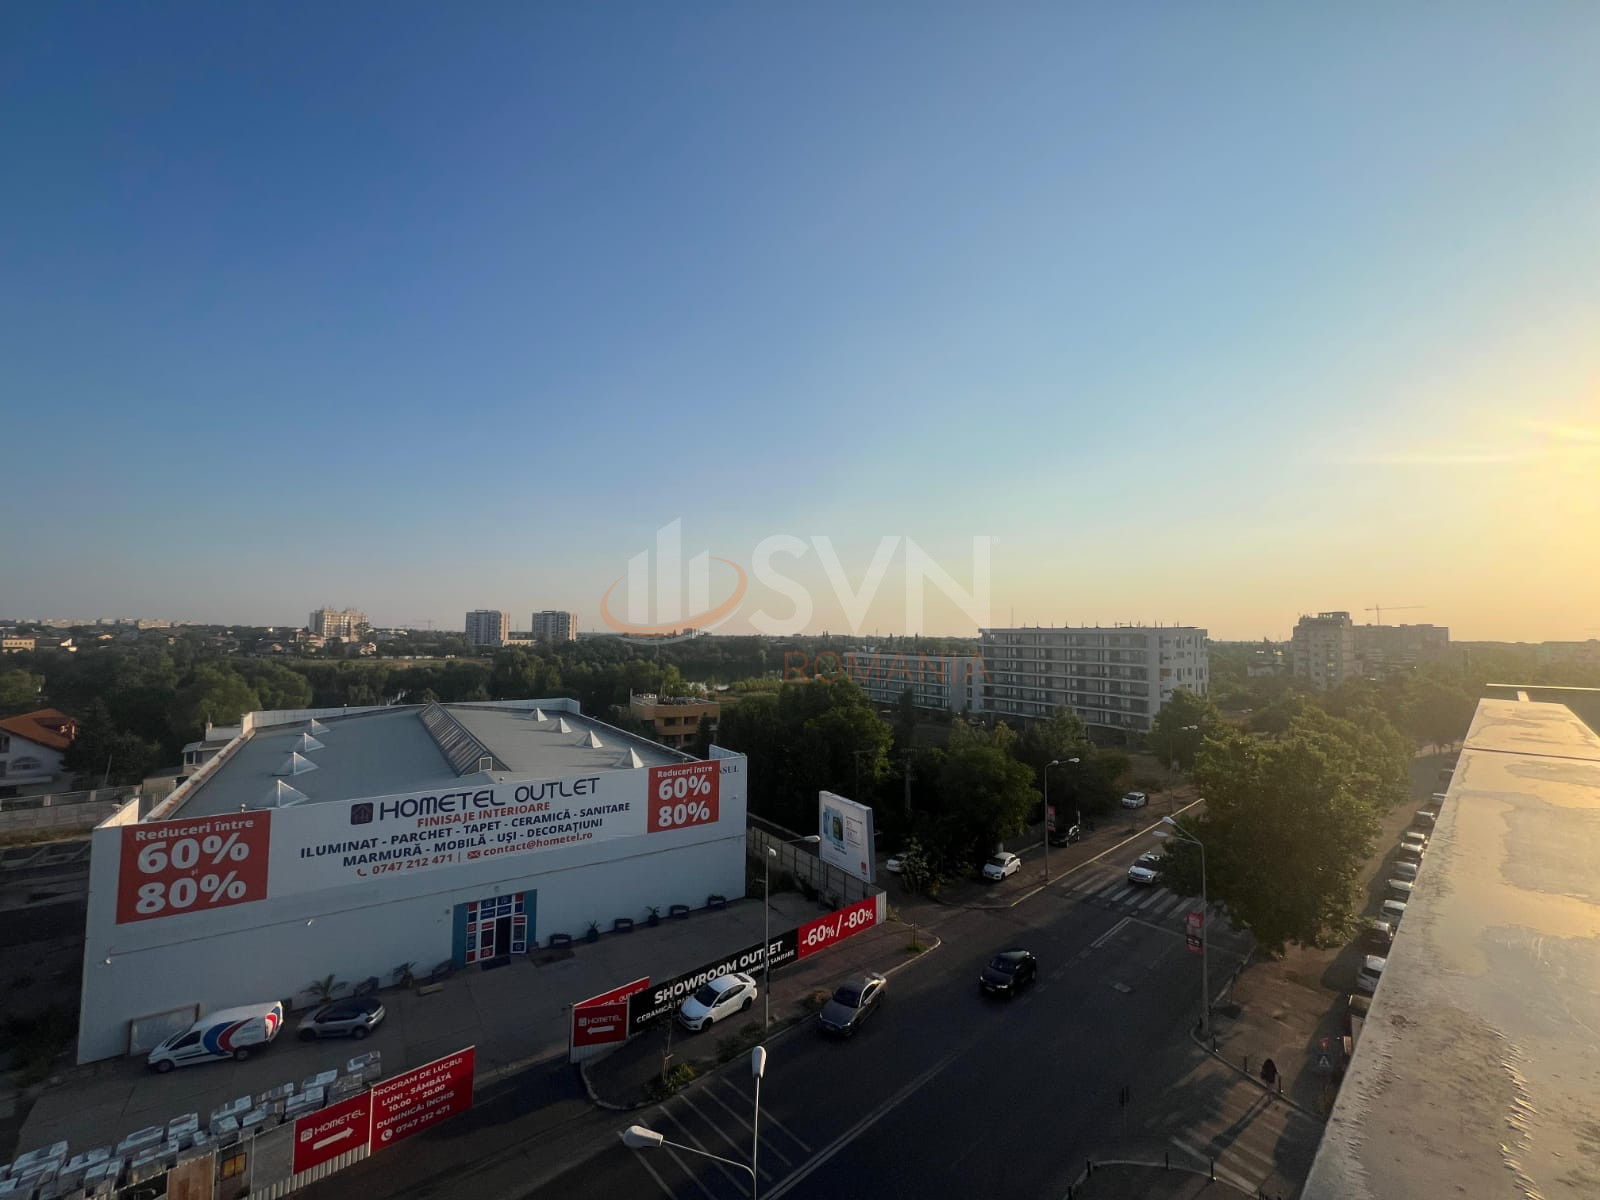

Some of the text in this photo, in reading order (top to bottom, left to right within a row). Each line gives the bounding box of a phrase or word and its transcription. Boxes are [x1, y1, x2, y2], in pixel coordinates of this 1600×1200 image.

[657, 767, 693, 778] Reduceri
[379, 777, 600, 821] HOMETEL OUTLET
[658, 774, 711, 800] 60%
[417, 802, 550, 828] FINISAJE INTERIOARE
[658, 800, 710, 827] 80%
[136, 819, 254, 841] Reduceri între
[300, 838, 379, 859] ILUMINAT
[391, 827, 452, 845] PARCHET
[463, 821, 501, 835] TAPET
[511, 808, 571, 828] CERAMICĂ
[579, 802, 630, 817] SANITARE
[137, 832, 249, 874] 60%
[343, 843, 422, 867] MARMURĂ
[434, 836, 486, 853] MOBILĂ
[372, 861, 402, 875] 0747
[406, 857, 429, 869] 212
[432, 853, 453, 864] 471
[483, 831, 593, 857] contact@hometel.ro
[136, 870, 247, 914] 80%
[654, 960, 737, 1006] SHOWROOM
[588, 1014, 622, 1024] HOMETEL
[372, 1075, 417, 1097] PROGRAM
[419, 1070, 432, 1080] DE
[381, 1092, 403, 1107] LUNI
[388, 1098, 412, 1112] 10.00
[422, 1084, 446, 1099] 20.00
[314, 1109, 366, 1135] HOMETEL
[395, 1104, 450, 1133] 0747 212 471
